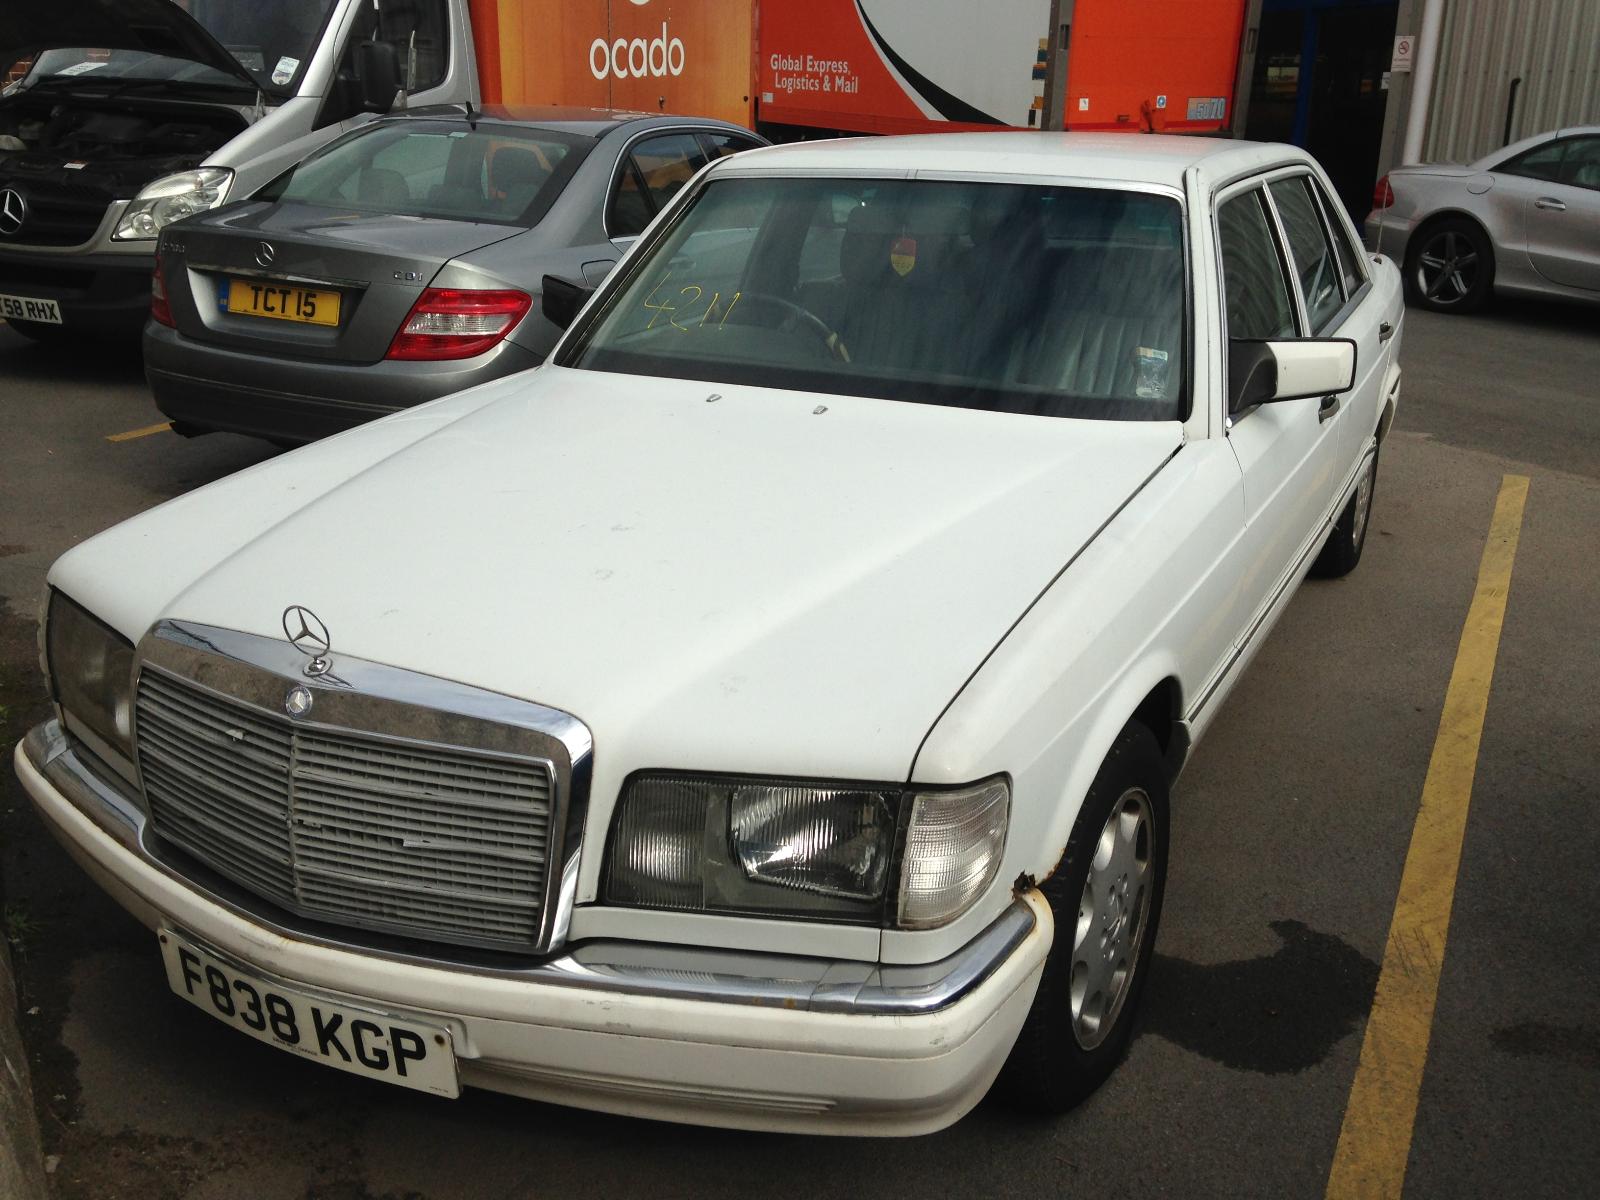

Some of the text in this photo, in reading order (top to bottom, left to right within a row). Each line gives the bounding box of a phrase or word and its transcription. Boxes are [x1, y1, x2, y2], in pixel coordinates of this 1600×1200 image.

[589, 21, 685, 80] ocado
[770, 53, 803, 71] Global
[775, 72, 859, 94] Logistics & Mail
[393, 270, 423, 281] CDI
[25, 300, 59, 321] RHX
[251, 285, 317, 318] TCT 15
[643, 271, 742, 331] 4211
[178, 946, 427, 1078] F838 KGP
